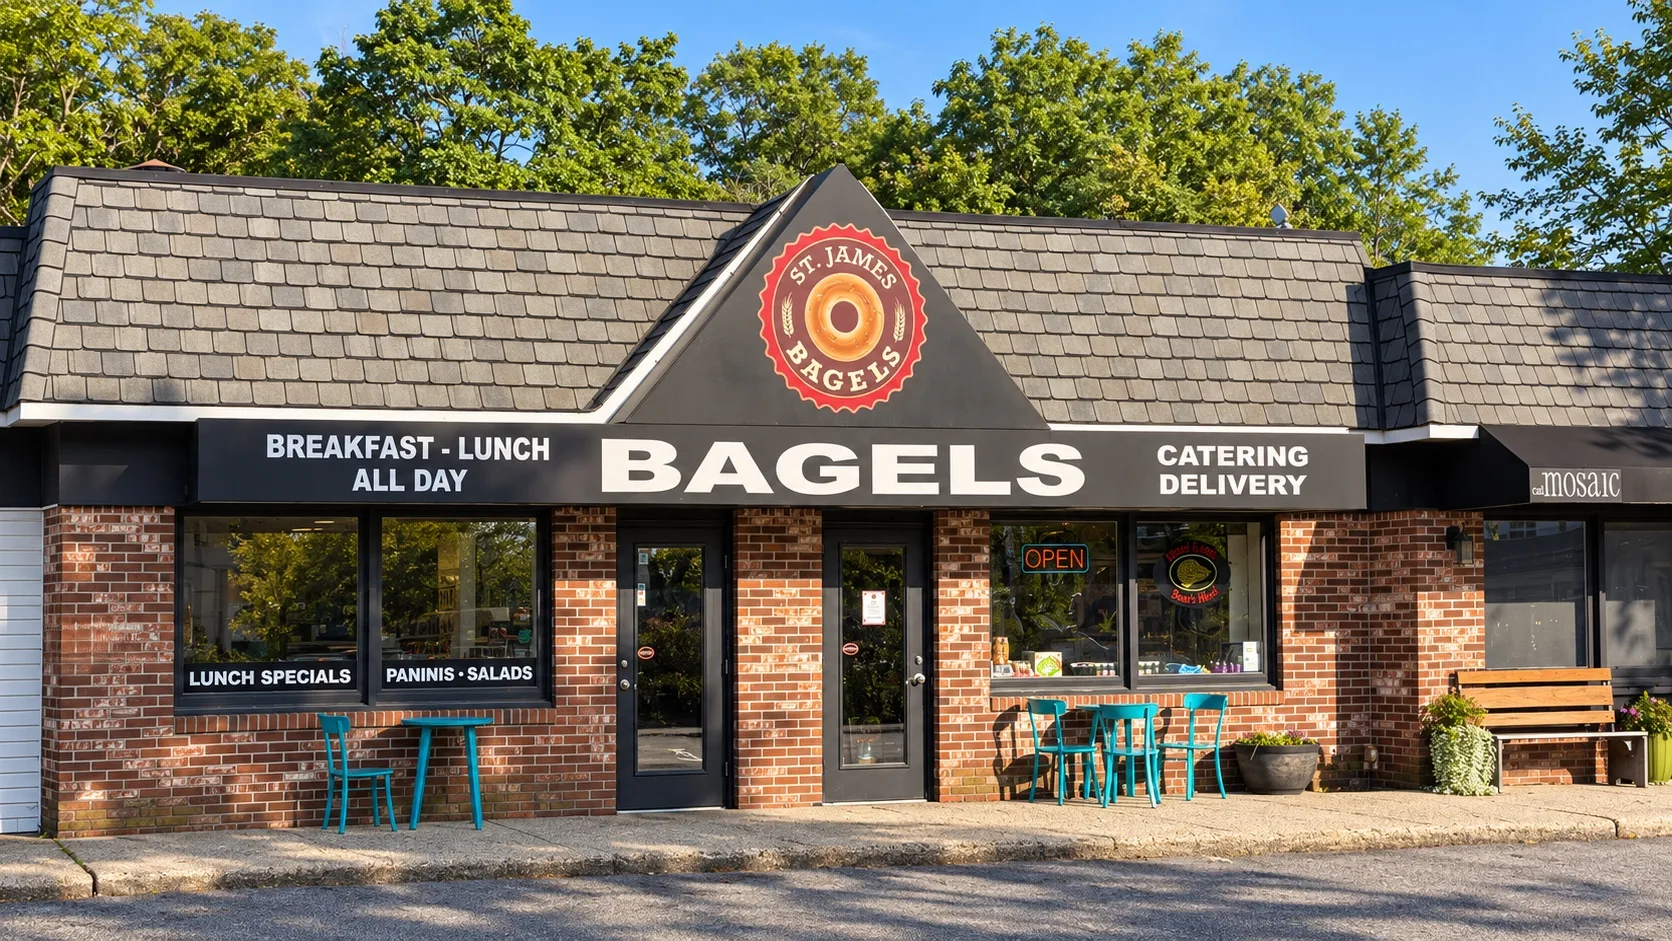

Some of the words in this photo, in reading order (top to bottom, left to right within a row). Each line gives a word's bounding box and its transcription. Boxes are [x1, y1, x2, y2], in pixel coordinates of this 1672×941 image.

[790, 254, 822, 286] ST.
[824, 245, 898, 290] JAMES
[785, 340, 901, 393] BAGELS
[266, 433, 435, 460] BREAKFAST
[458, 436, 550, 461] LUNCH
[1156, 444, 1309, 468] CATERING
[601, 438, 1086, 497] BAGELS
[352, 468, 405, 492] ALL
[414, 468, 468, 492] DAY
[1159, 473, 1308, 496] DELIVERY
[1542, 471, 1621, 498] mosaic
[1025, 548, 1084, 569] OPEN
[189, 670, 255, 686] LUNCH
[260, 668, 352, 685] SPECIALS
[386, 666, 455, 683] PANINIS
[467, 665, 533, 681] SALADS
